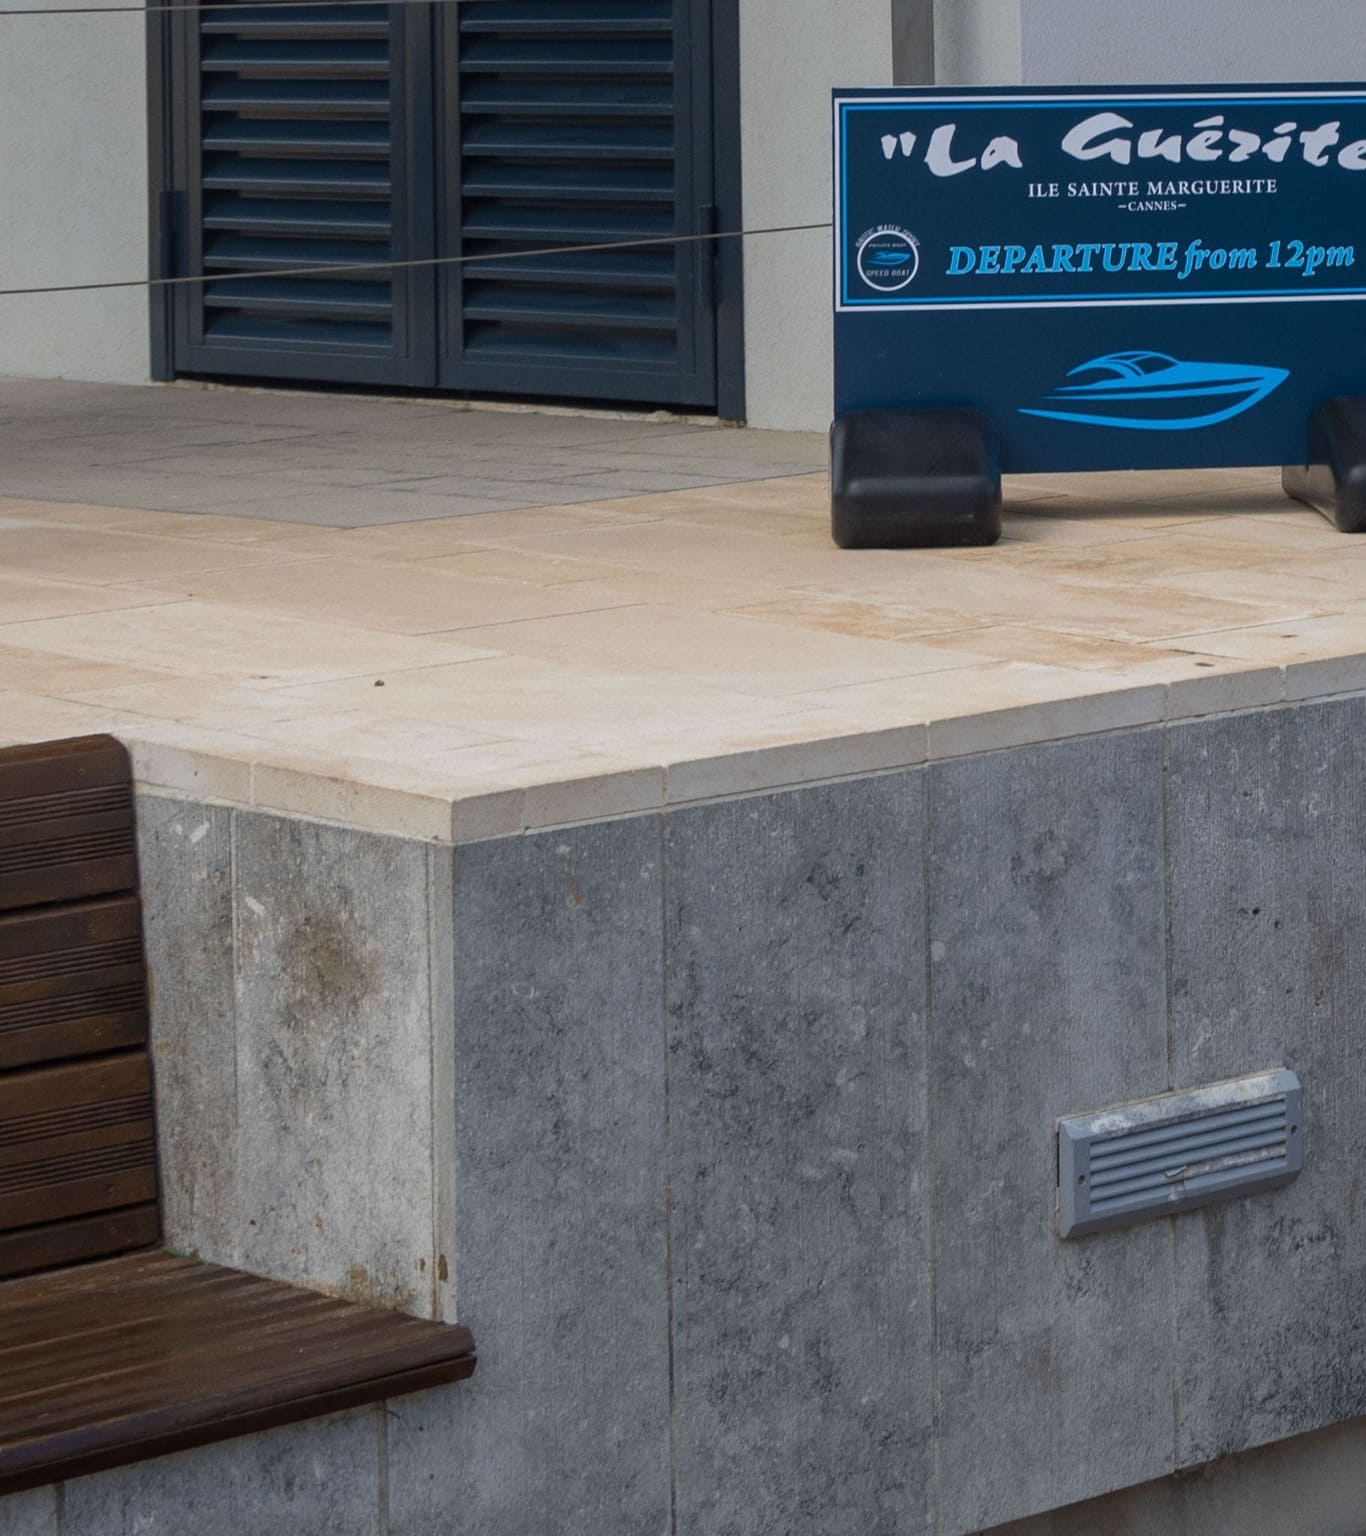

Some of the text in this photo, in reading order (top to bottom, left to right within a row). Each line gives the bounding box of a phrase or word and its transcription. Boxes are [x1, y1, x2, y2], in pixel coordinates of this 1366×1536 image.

[881, 123, 1023, 177] "La
[1028, 178, 1278, 199] ILE SAINTE MARGUERITE
[946, 239, 1355, 279] DEPARTURE from 12pm
